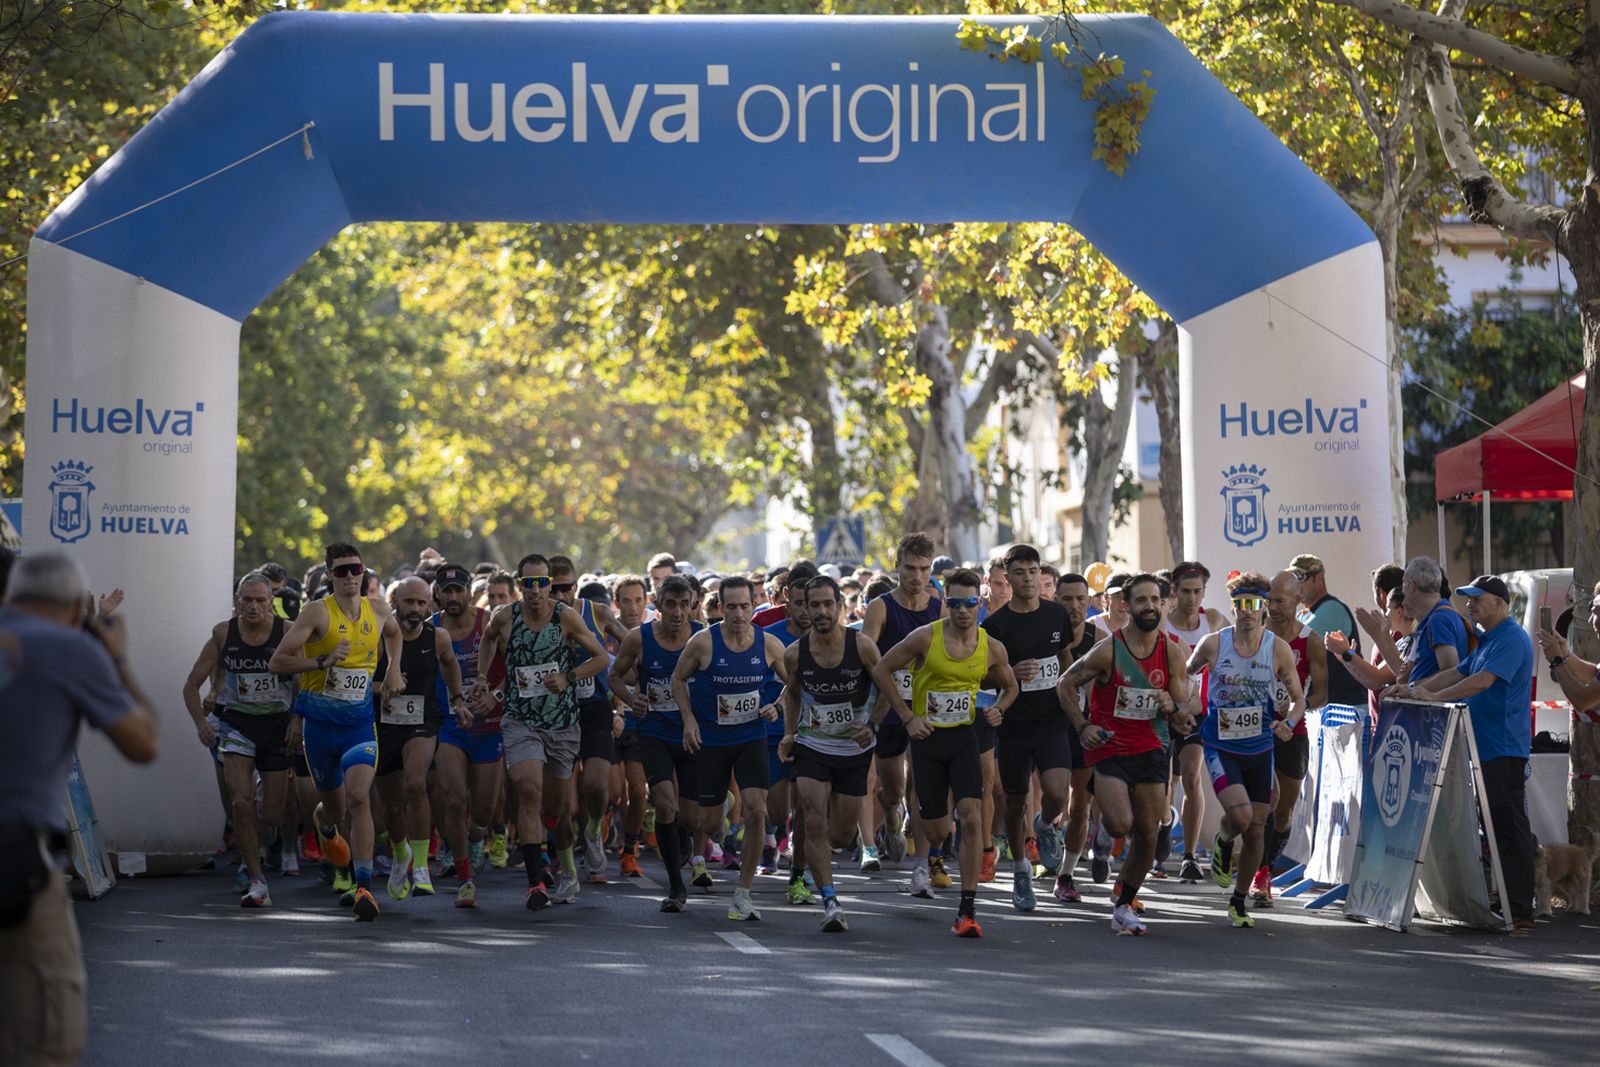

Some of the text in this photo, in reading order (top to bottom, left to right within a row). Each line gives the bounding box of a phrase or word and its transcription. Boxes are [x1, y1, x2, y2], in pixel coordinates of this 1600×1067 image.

[378, 62, 1046, 163] Huelva original
[52, 398, 193, 437] Huelva
[1220, 398, 1359, 438] Huelva
[143, 440, 193, 456] original
[1314, 438, 1360, 454] original
[102, 502, 190, 514] Ayuntamiento de
[1278, 501, 1361, 515] Ayuntamiento de
[101, 516, 189, 535] HUELVA
[1278, 515, 1361, 534] HUELVA
[1040, 662, 1058, 679] 139
[254, 677, 275, 692] 251
[344, 675, 366, 689] 302
[406, 701, 415, 714] 6
[734, 697, 756, 713] 469
[946, 697, 968, 713] 246
[827, 708, 852, 724] 388
[1235, 712, 1259, 728] 496
